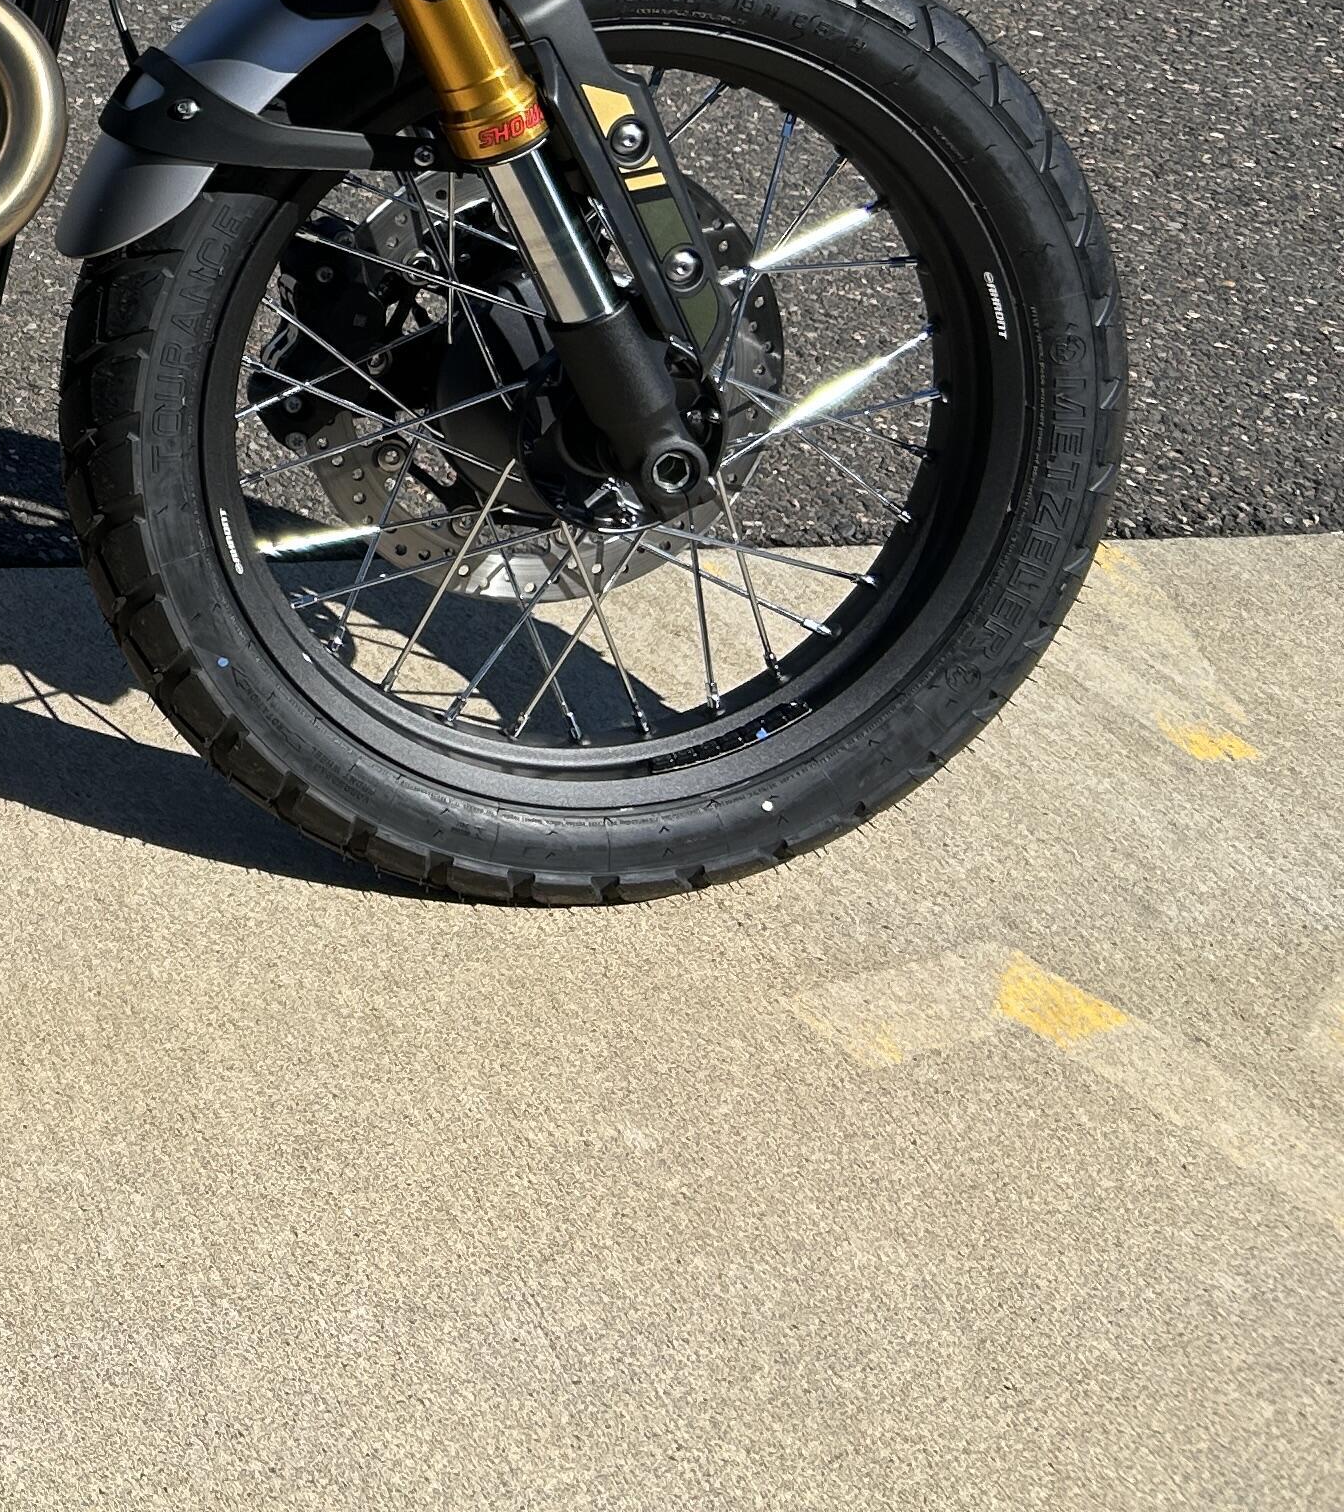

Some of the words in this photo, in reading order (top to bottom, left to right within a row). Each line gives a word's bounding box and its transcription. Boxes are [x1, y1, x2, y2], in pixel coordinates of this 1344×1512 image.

[478, 103, 545, 149] SHOW
[150, 202, 246, 475] TOURANCE
[979, 374, 1089, 660] METZELER
